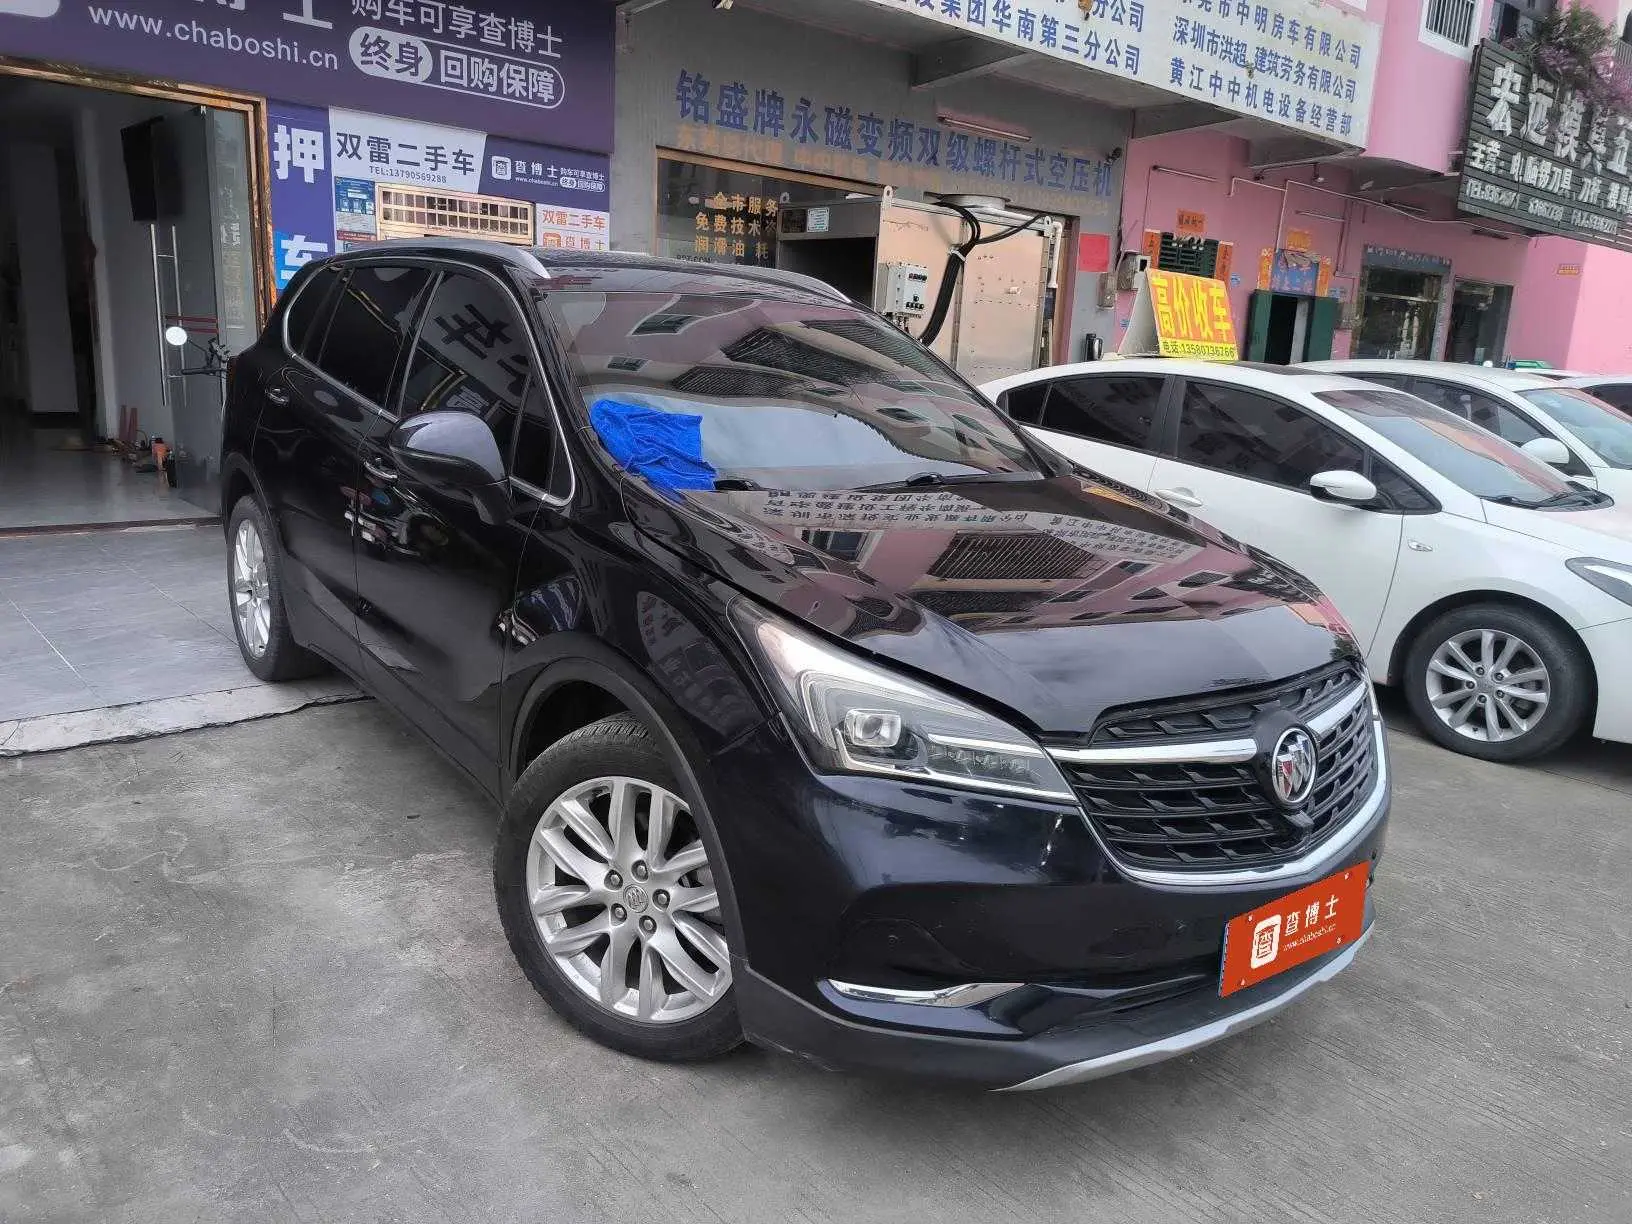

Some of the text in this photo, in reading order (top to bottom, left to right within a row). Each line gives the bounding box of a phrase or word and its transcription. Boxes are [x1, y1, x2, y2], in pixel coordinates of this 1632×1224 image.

[88, 6, 338, 70] www.chaboshi.cn
[352, 0, 563, 59] 购车可享查博士
[1183, 0, 1361, 69] 市中明房车有限公司
[359, 33, 555, 103] 终身 回购保障
[1170, 57, 1353, 136] 黄江中中机电设备经营部
[336, 132, 475, 175] 双雷二手车
[675, 67, 1113, 197] 铭盛牌永磁变频双级螺杆式空压机
[514, 160, 558, 179] 查博士
[542, 209, 607, 231] 双雷二手车
[1152, 276, 1231, 342] 高价收车
[1285, 894, 1339, 937] 查博士
